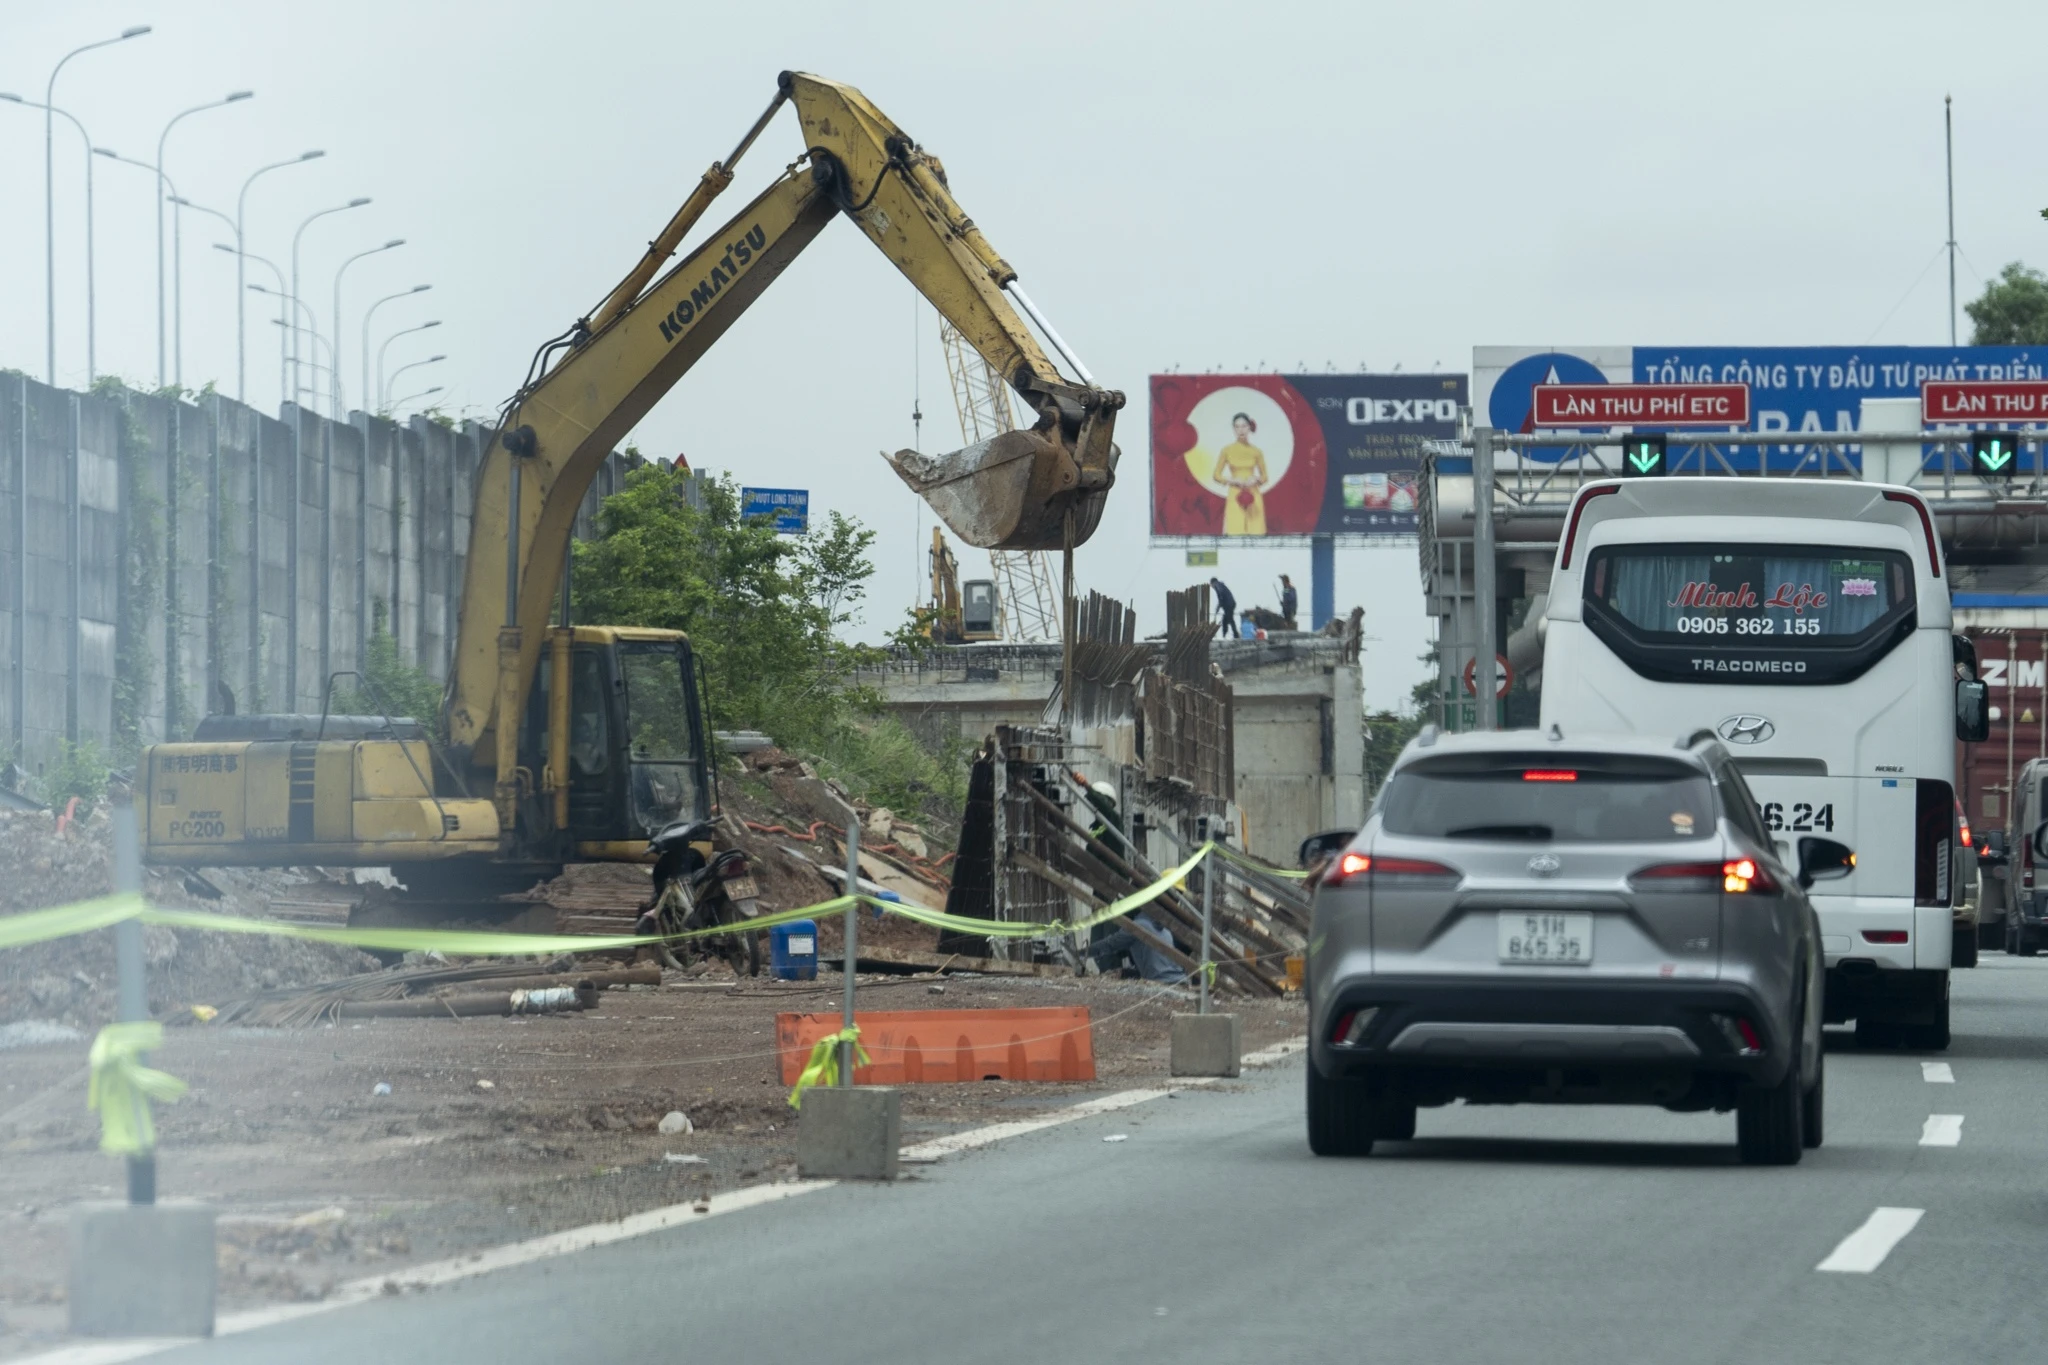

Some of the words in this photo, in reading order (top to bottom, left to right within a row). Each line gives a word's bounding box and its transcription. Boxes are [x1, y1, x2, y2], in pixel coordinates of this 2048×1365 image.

[659, 224, 766, 343] KOMATSU
[1646, 356, 1713, 384] TỔNG
[1721, 359, 1787, 388] CÔNG
[1795, 365, 1823, 388] TY
[1829, 354, 1875, 388] ĐẦU
[1881, 361, 1910, 388] TƯ
[1975, 352, 2042, 382] TRIỂN
[1346, 397, 1457, 425] OEXPO
[1553, 394, 1595, 415] LÀN
[1602, 398, 1643, 415] THU
[1650, 393, 1684, 414] PHÍ
[1691, 397, 1729, 414] ETC
[1942, 391, 1986, 412] LÀN
[1992, 394, 2034, 412] THU
[1667, 581, 1758, 608] Minh
[1764, 582, 1828, 615] Lộc
[1677, 617, 1729, 635] 0905
[1735, 618, 1775, 635] 362
[1783, 618, 1820, 635] 155
[1691, 659, 1807, 673] TRACOMECO
[1980, 658, 2046, 688] ZIM
[168, 820, 225, 838] PC200
